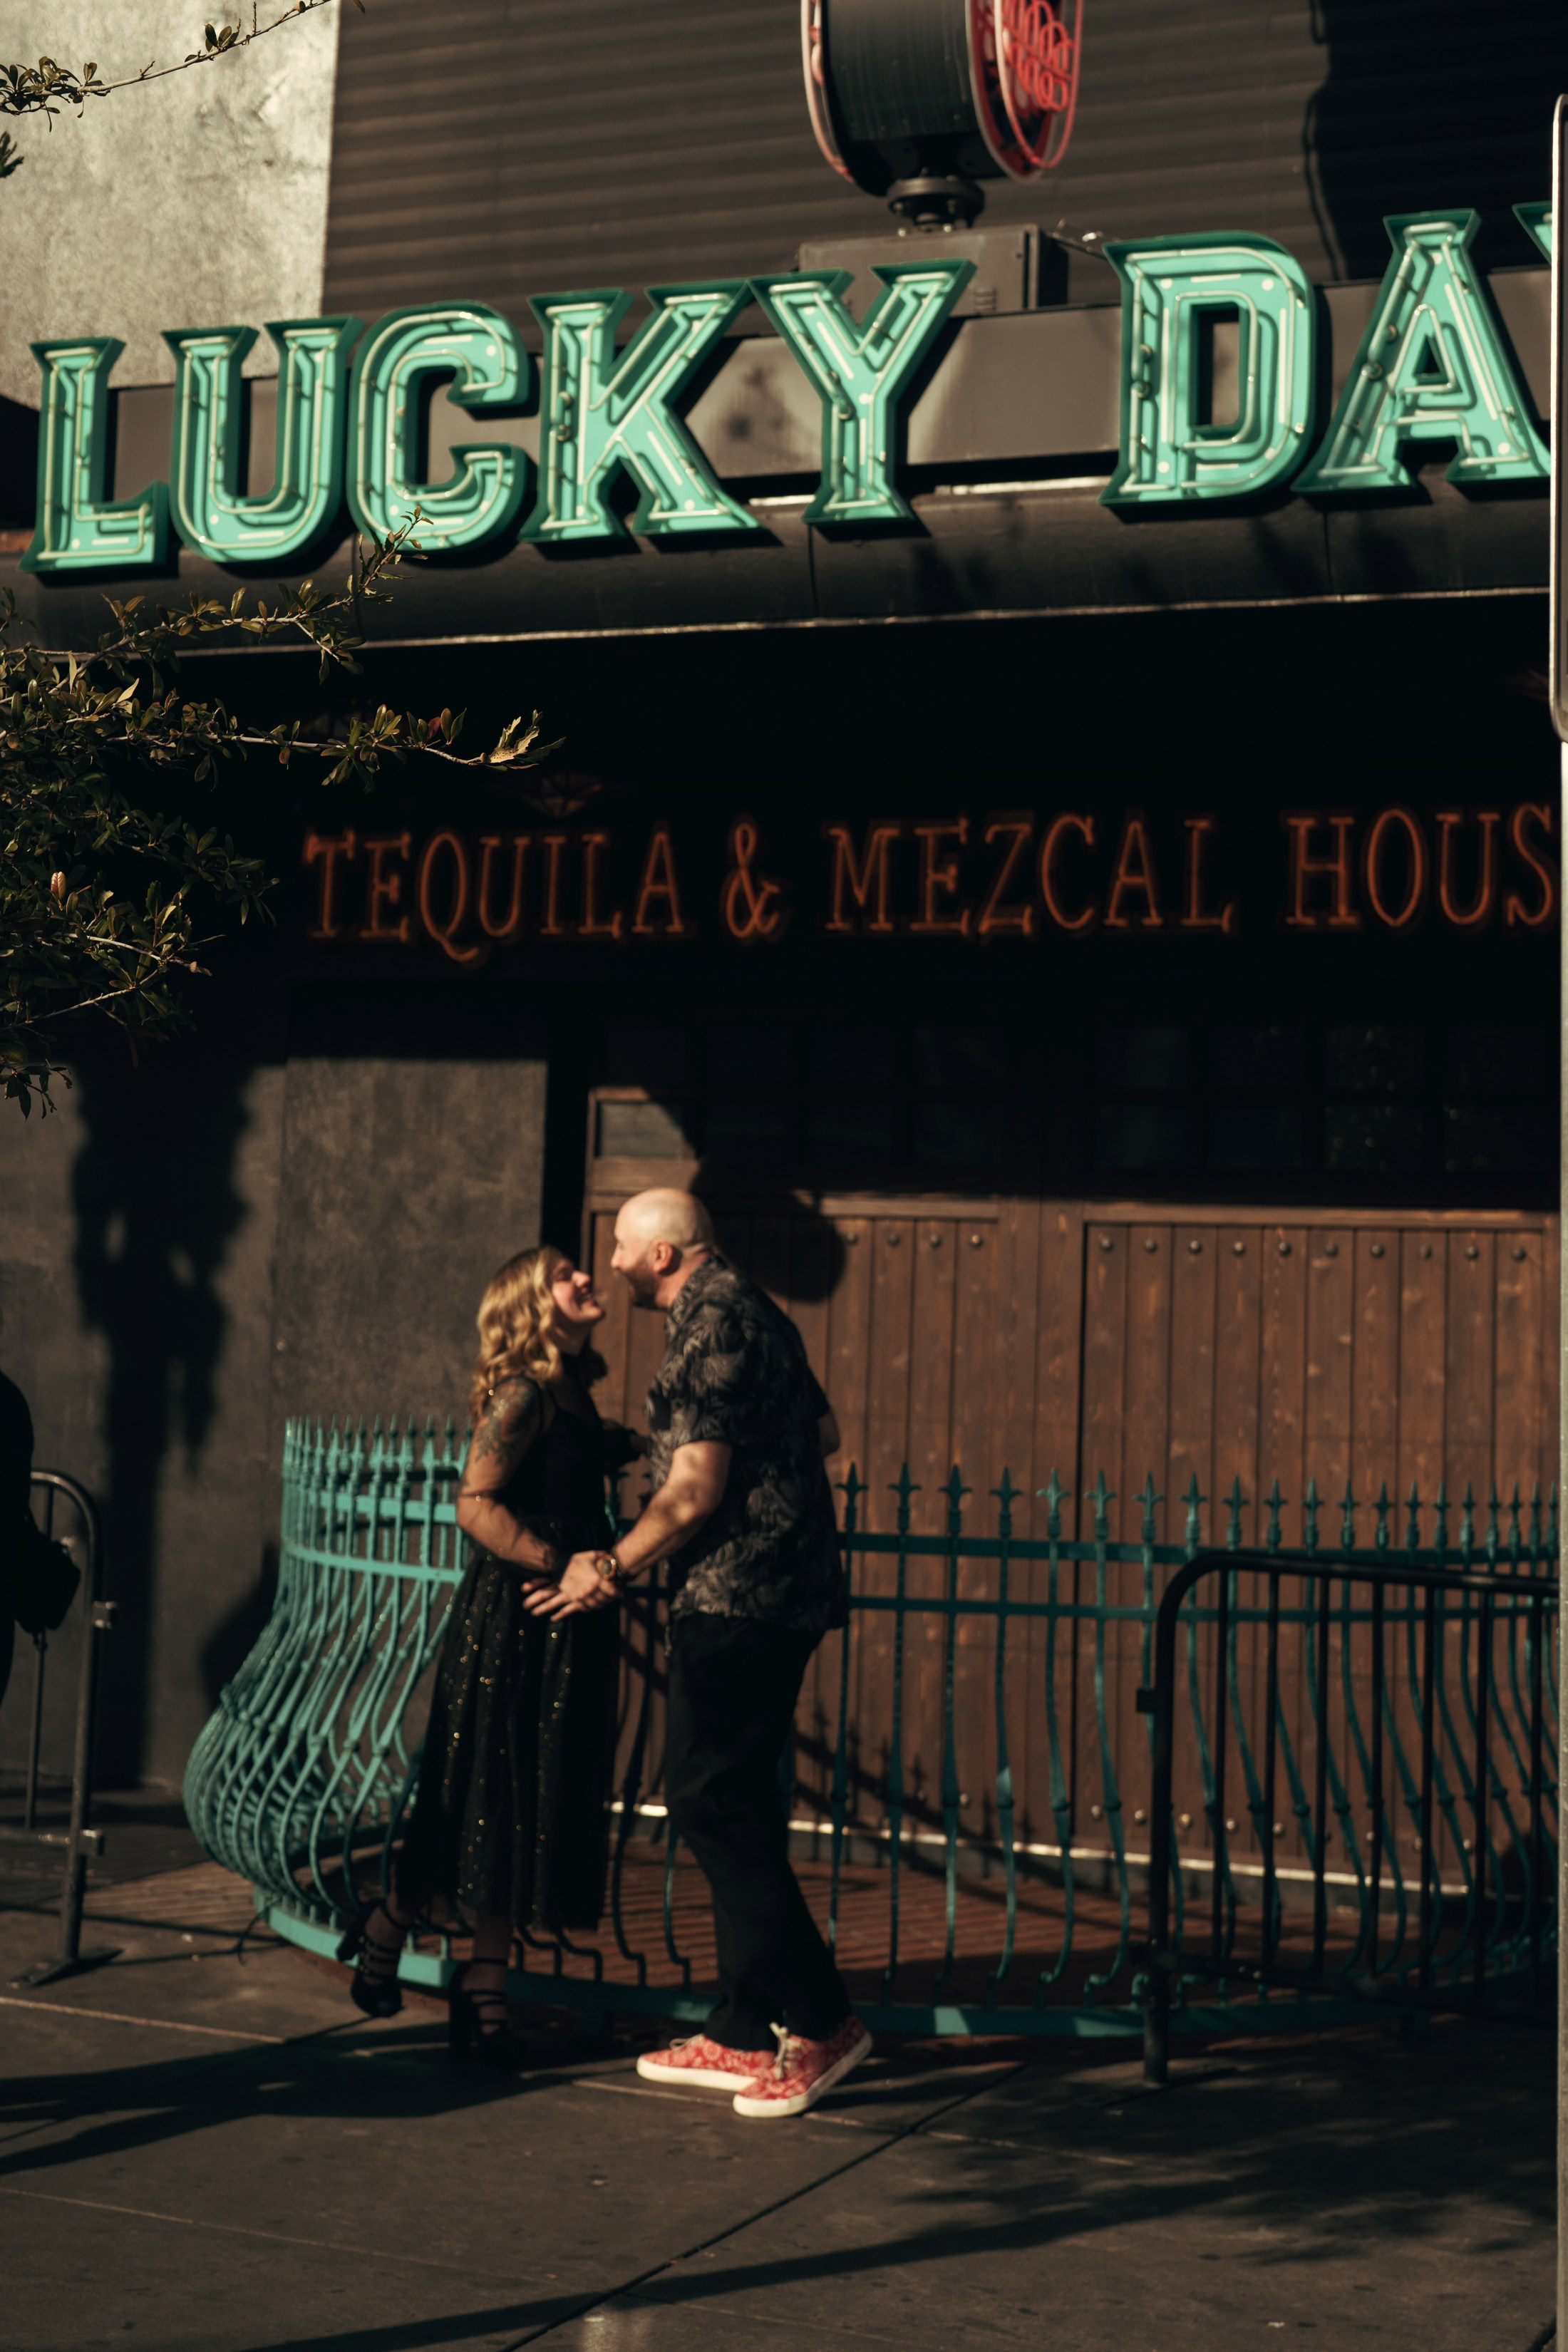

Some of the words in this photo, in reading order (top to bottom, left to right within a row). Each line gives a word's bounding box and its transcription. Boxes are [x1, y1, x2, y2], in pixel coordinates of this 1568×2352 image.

[18, 258, 978, 572] LUCKY
[1098, 202, 1552, 506] DA
[302, 827, 686, 963] TEQUILA
[724, 820, 785, 939] &
[824, 811, 1234, 937] MEZCAL
[1284, 803, 1553, 928] HOUS
